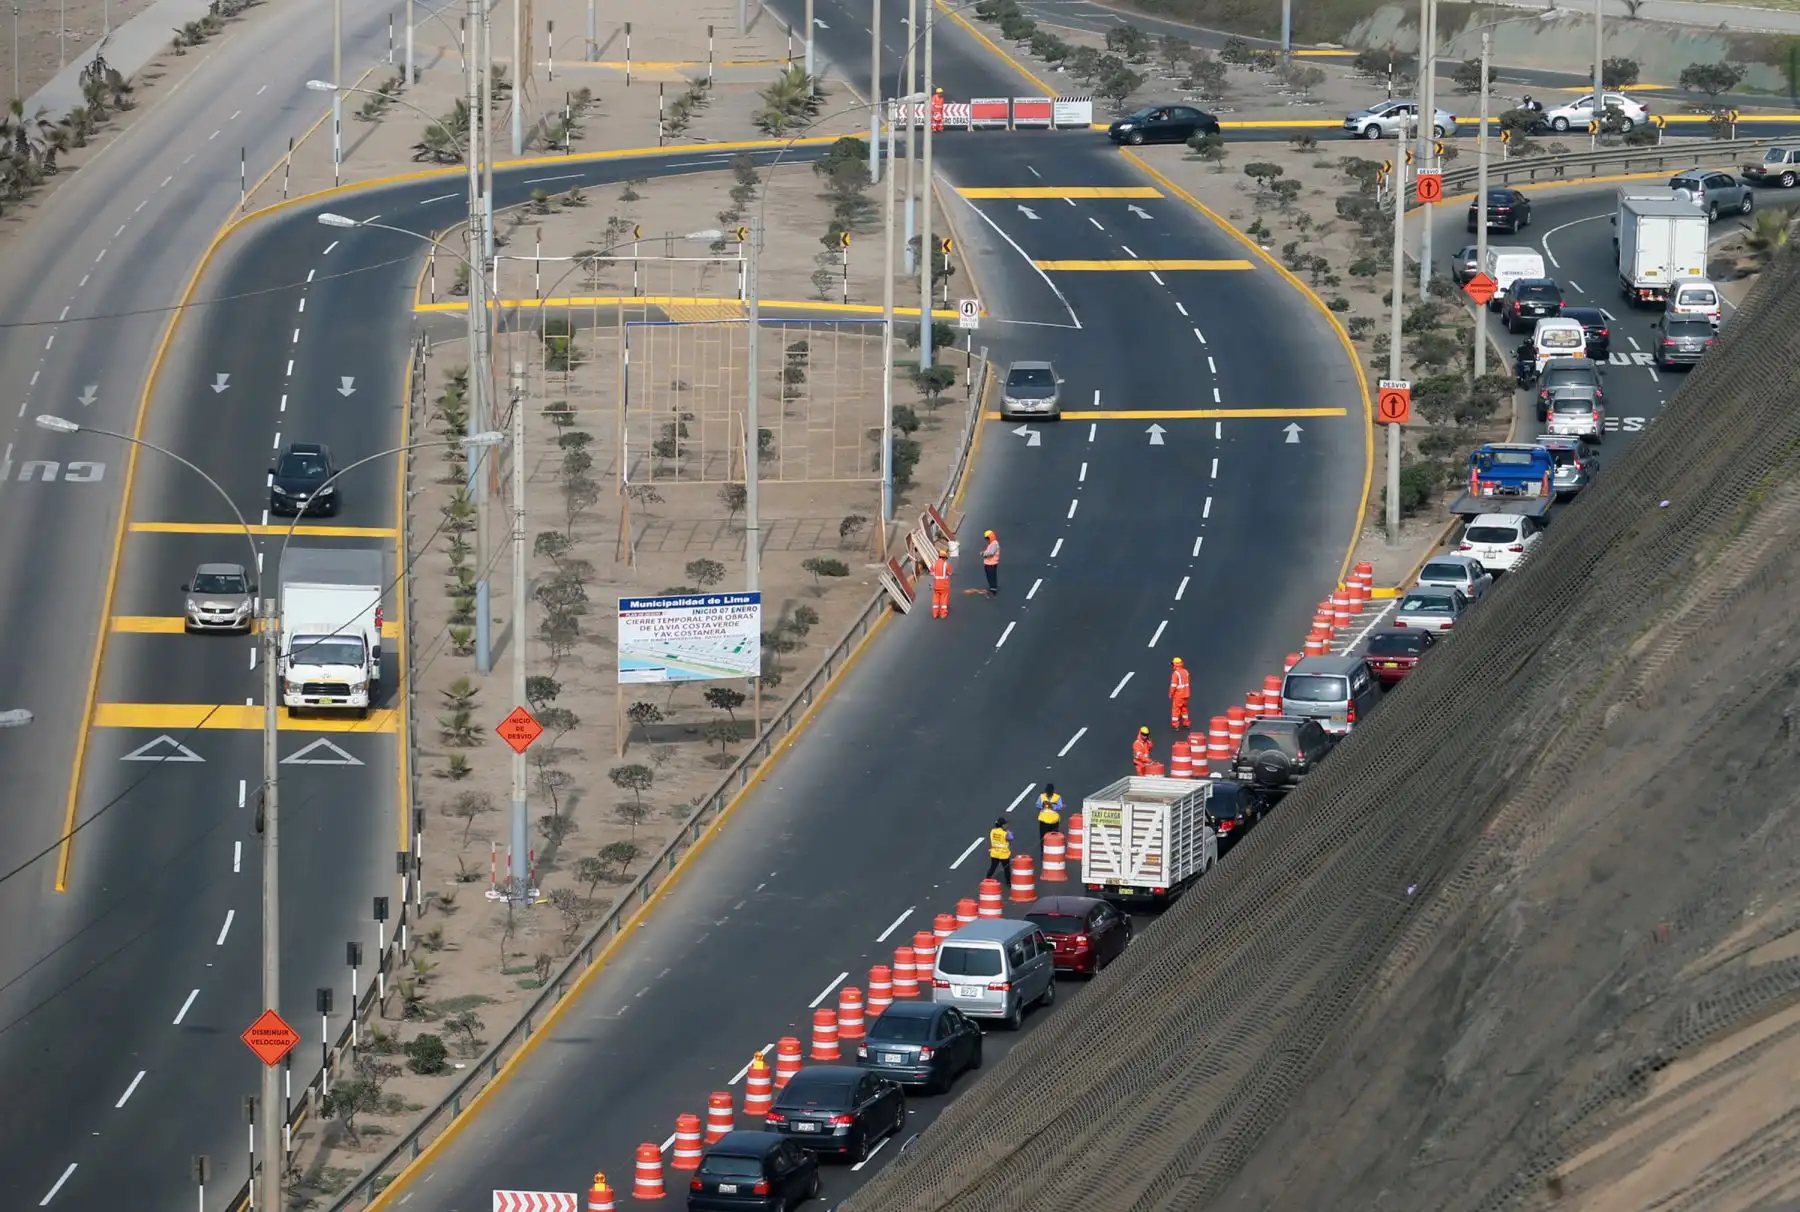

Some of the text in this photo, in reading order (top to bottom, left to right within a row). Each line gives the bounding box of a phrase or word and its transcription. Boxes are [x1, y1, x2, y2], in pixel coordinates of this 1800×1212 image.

[1595, 352, 1657, 366] UR
[1382, 381, 1407, 389] DESVIO
[630, 596, 750, 609] Municipalidad de Lima
[626, 618, 655, 626] CIERRE
[657, 616, 702, 624] TEMPORAL
[725, 613, 754, 621] OBRAS
[682, 622, 711, 630] COSTA
[712, 621, 740, 629] VERDE
[674, 628, 726, 637] COSTANERA
[1091, 810, 1121, 820] TAXI CARGO
